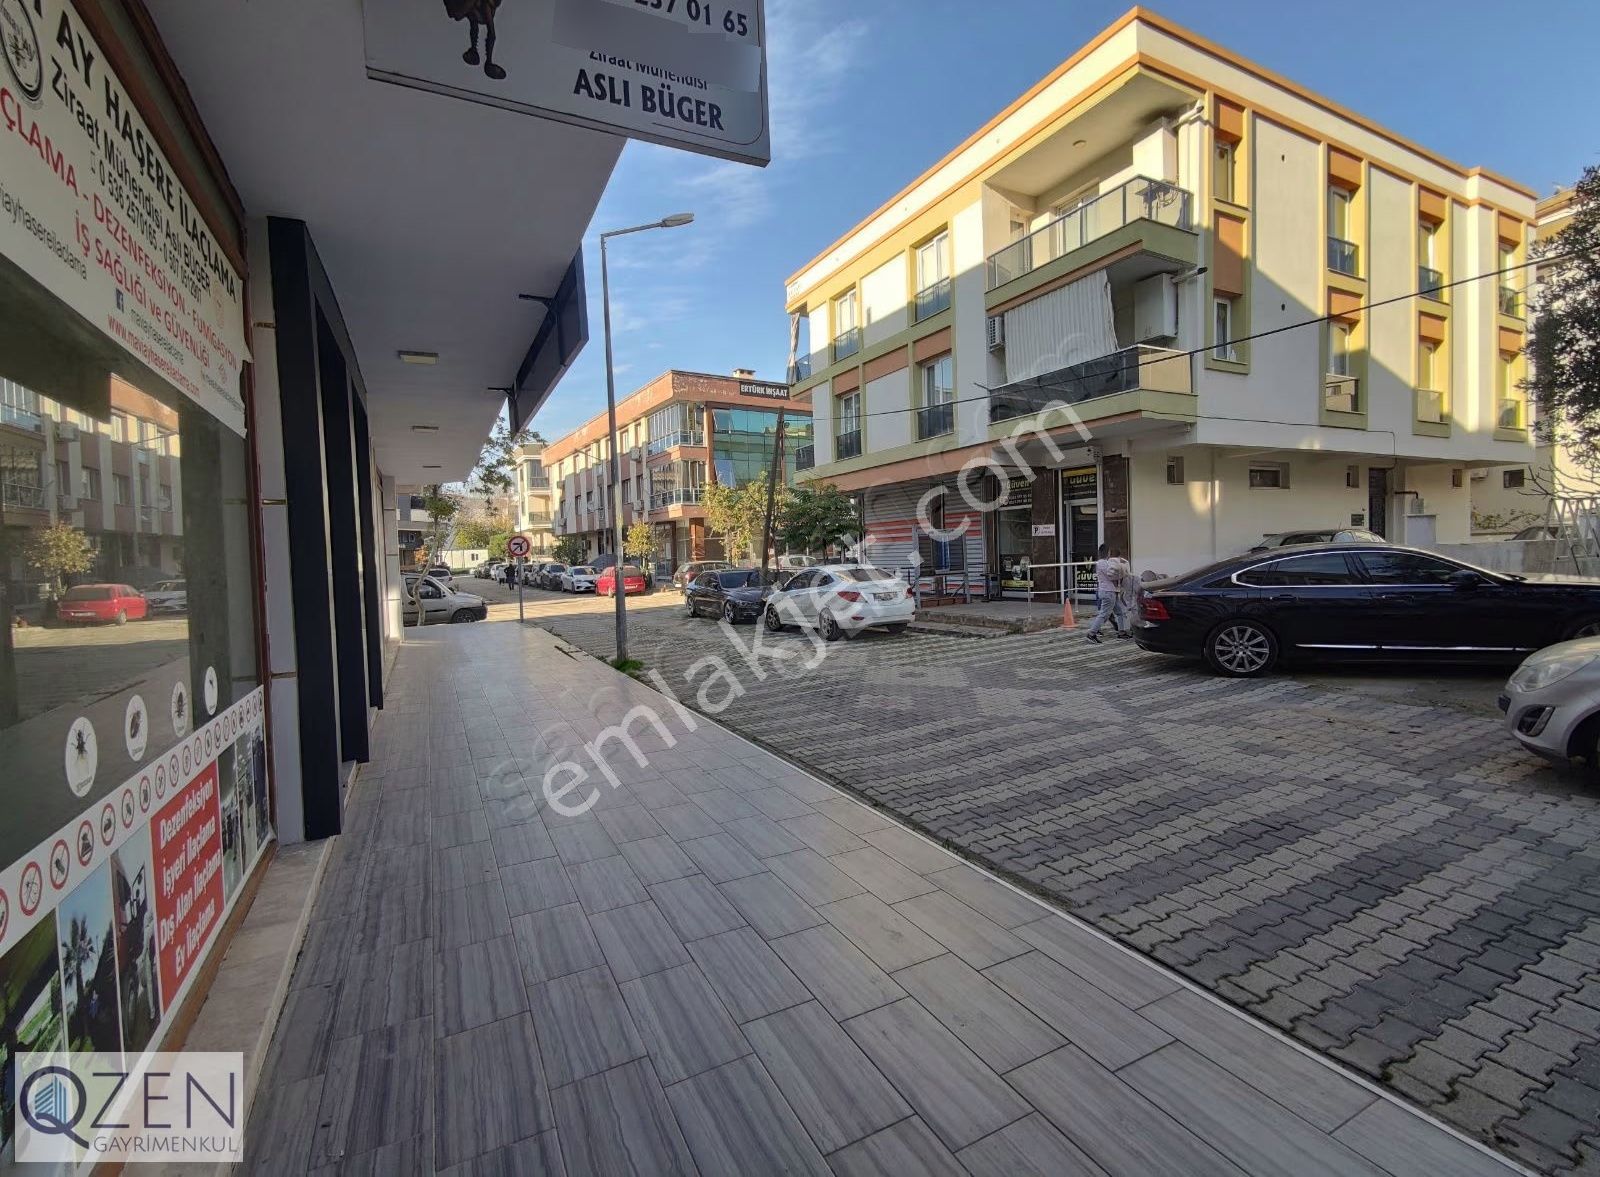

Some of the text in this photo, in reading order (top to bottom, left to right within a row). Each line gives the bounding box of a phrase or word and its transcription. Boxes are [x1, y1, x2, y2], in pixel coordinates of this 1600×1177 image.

[686, 0, 711, 26] 01
[723, 10, 747, 37] 65
[573, 68, 725, 131] ASLI BÜGER
[51, 53, 100, 150] Ziraat
[104, 129, 164, 234] Mühendisi
[56, 9, 95, 91] AY
[104, 74, 175, 212] HAŞERE
[179, 187, 238, 303] İLAÇLAMA
[0, 86, 78, 197] ÇLAMA
[94, 191, 185, 315] DEZENFEKSİYON
[75, 209, 90, 257] İŞ
[95, 237, 147, 309] SAĞLIĞI
[150, 301, 162, 323] ve
[740, 384, 765, 394] ERTÜRK
[1075, 570, 1098, 581] Güve
[160, 778, 214, 850] Dezenfeksiyon
